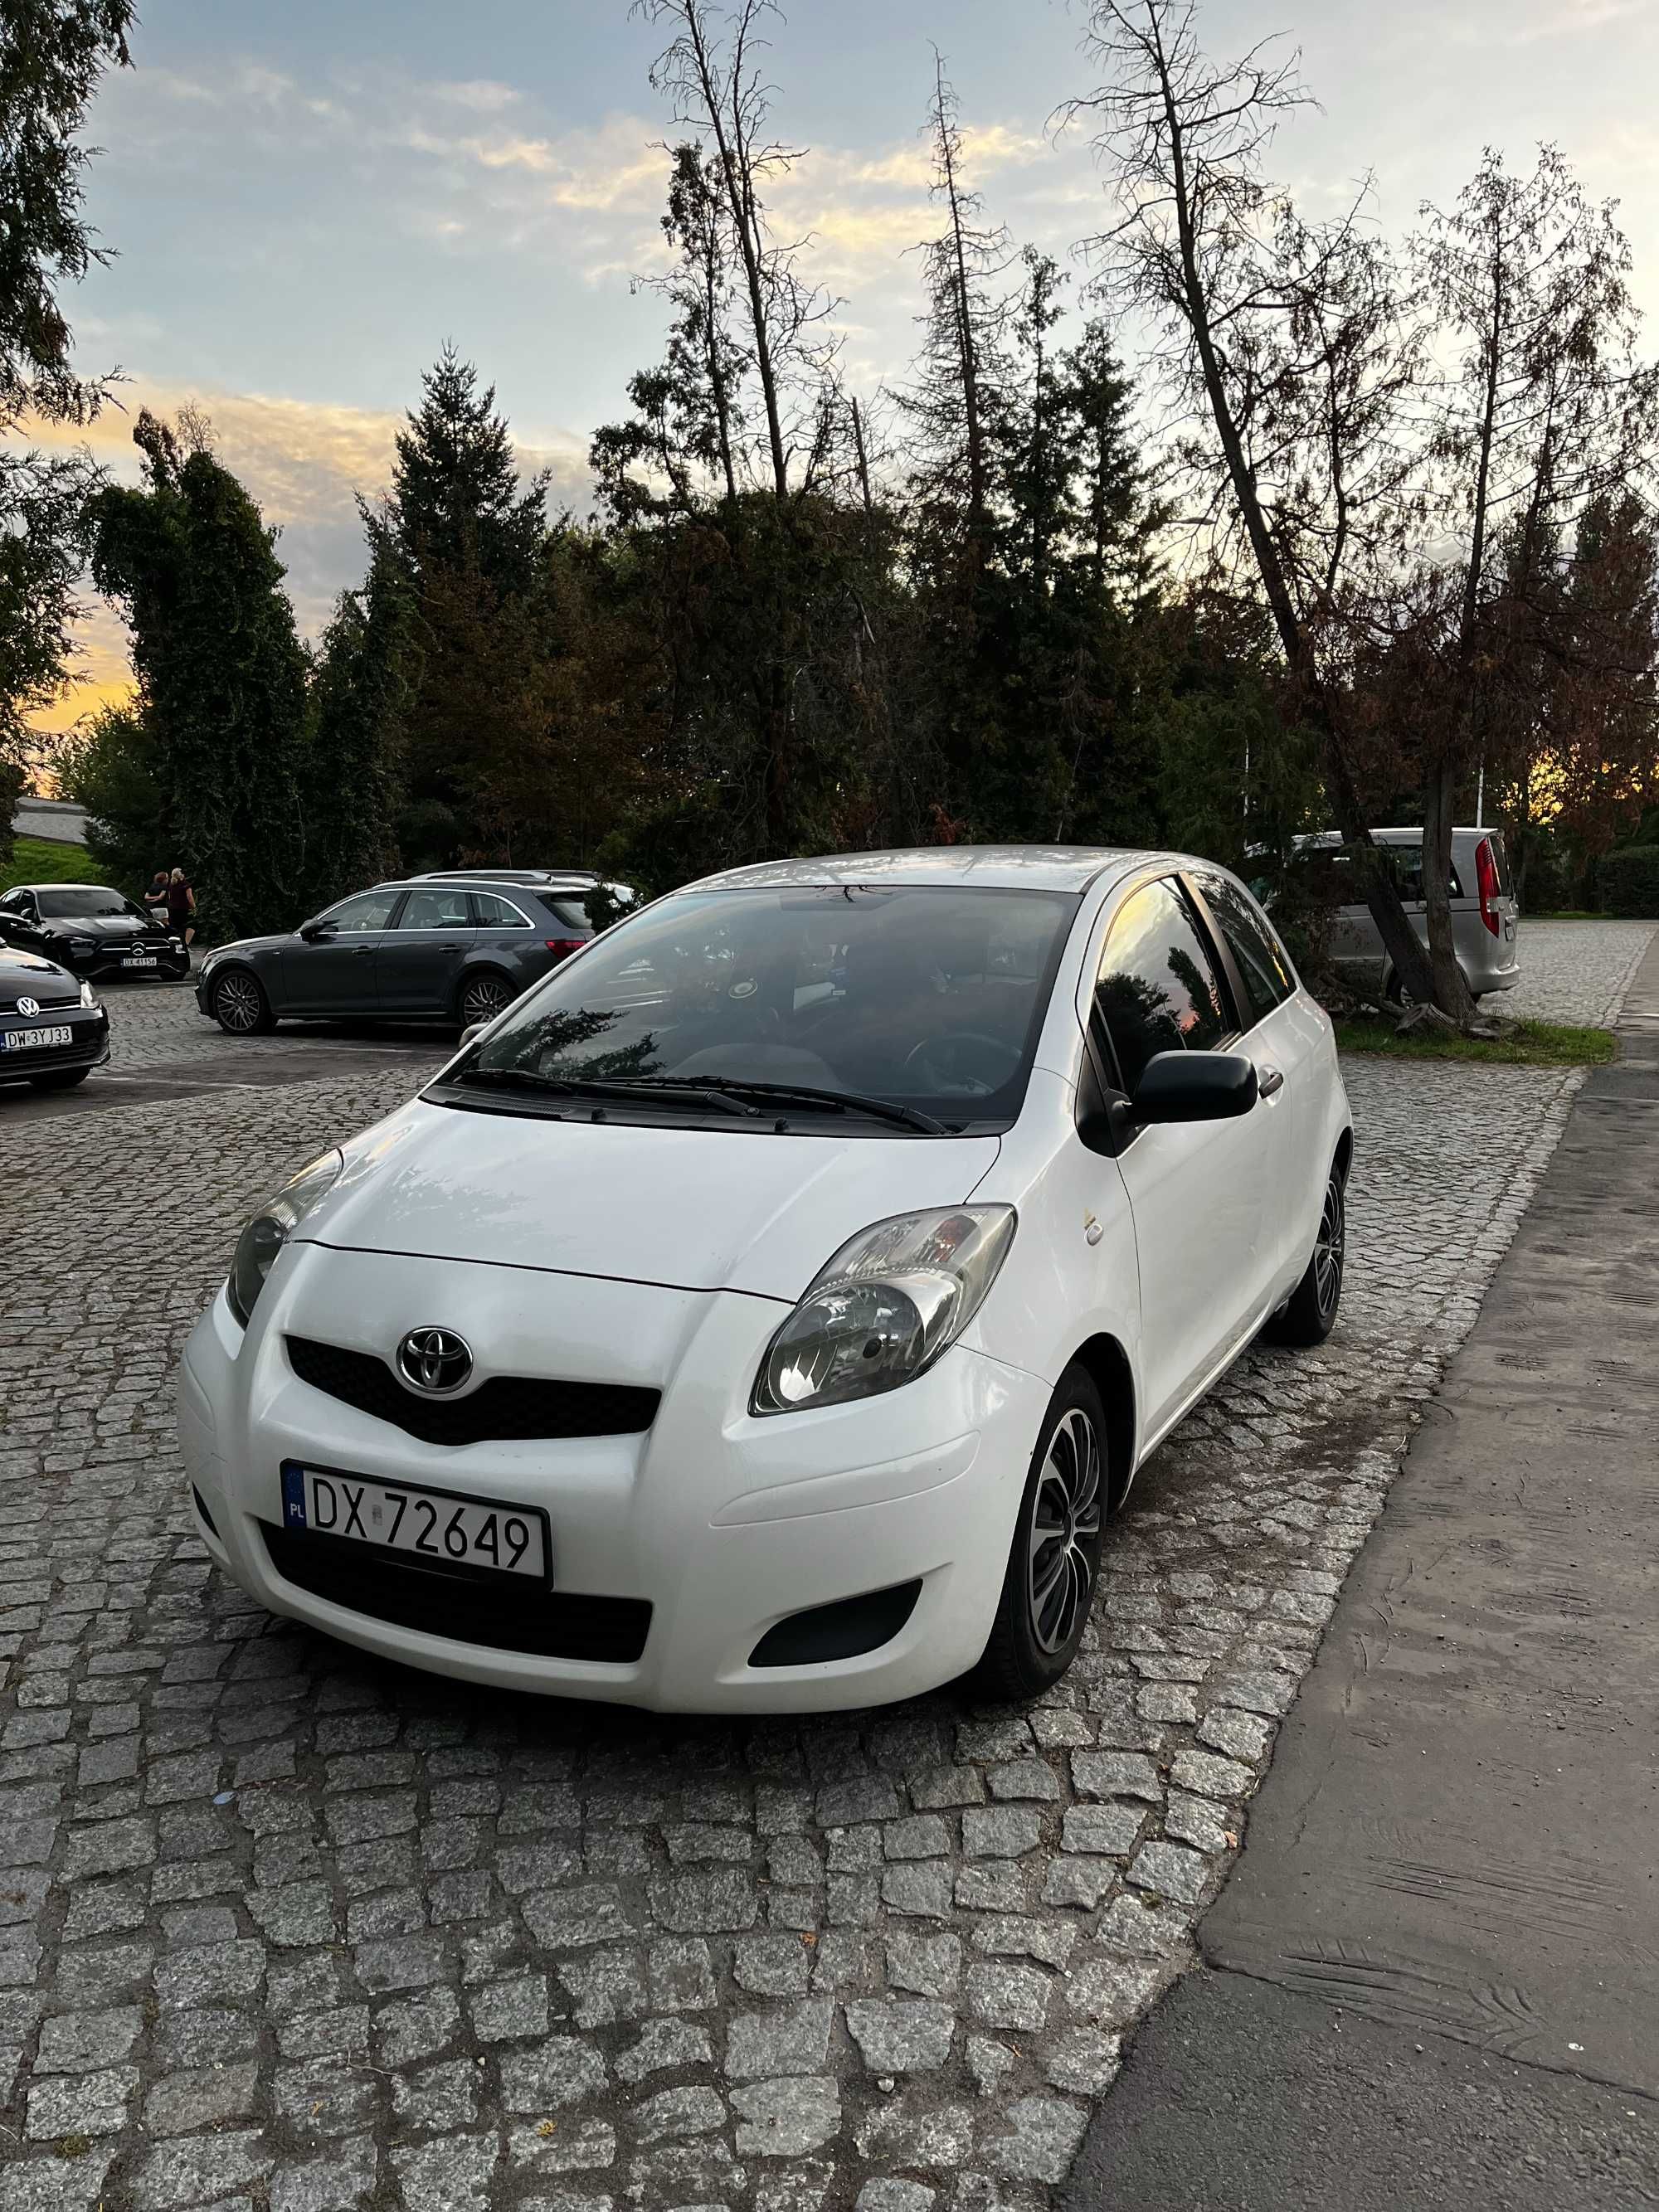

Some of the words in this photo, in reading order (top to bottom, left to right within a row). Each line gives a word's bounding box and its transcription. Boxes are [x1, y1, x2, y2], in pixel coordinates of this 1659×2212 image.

[8, 1033, 26, 1047] DW
[31, 1028, 70, 1044] 3YJ33
[290, 1503, 304, 1518] PL
[313, 1478, 367, 1538] DX
[385, 1492, 530, 1569] 72649
